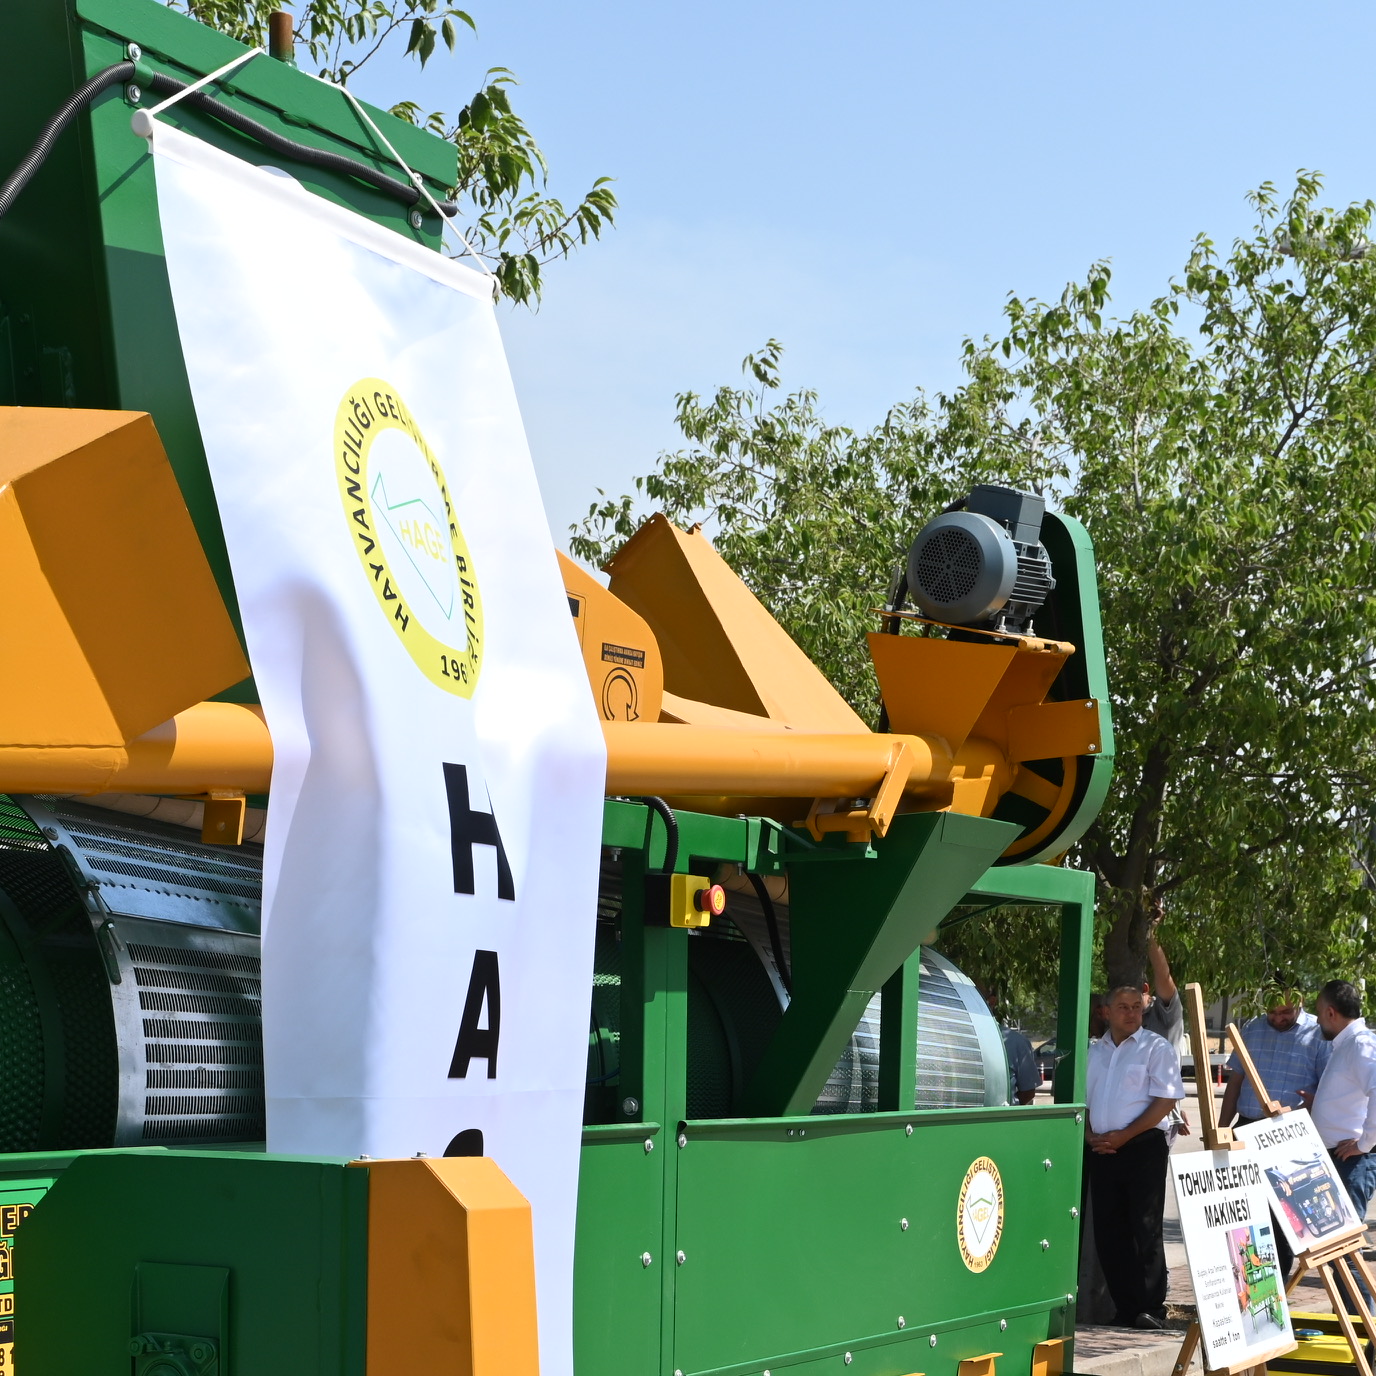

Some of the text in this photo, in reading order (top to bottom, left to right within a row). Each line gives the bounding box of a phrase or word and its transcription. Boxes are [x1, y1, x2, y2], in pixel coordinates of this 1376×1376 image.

[1254, 1120, 1309, 1150] JENERATÖR
[1178, 1159, 1262, 1197] TOHUM SELEKTÖR
[1204, 1193, 1251, 1228] MAKİNESİ
[1212, 1331, 1241, 1348] saatte 1 ton
